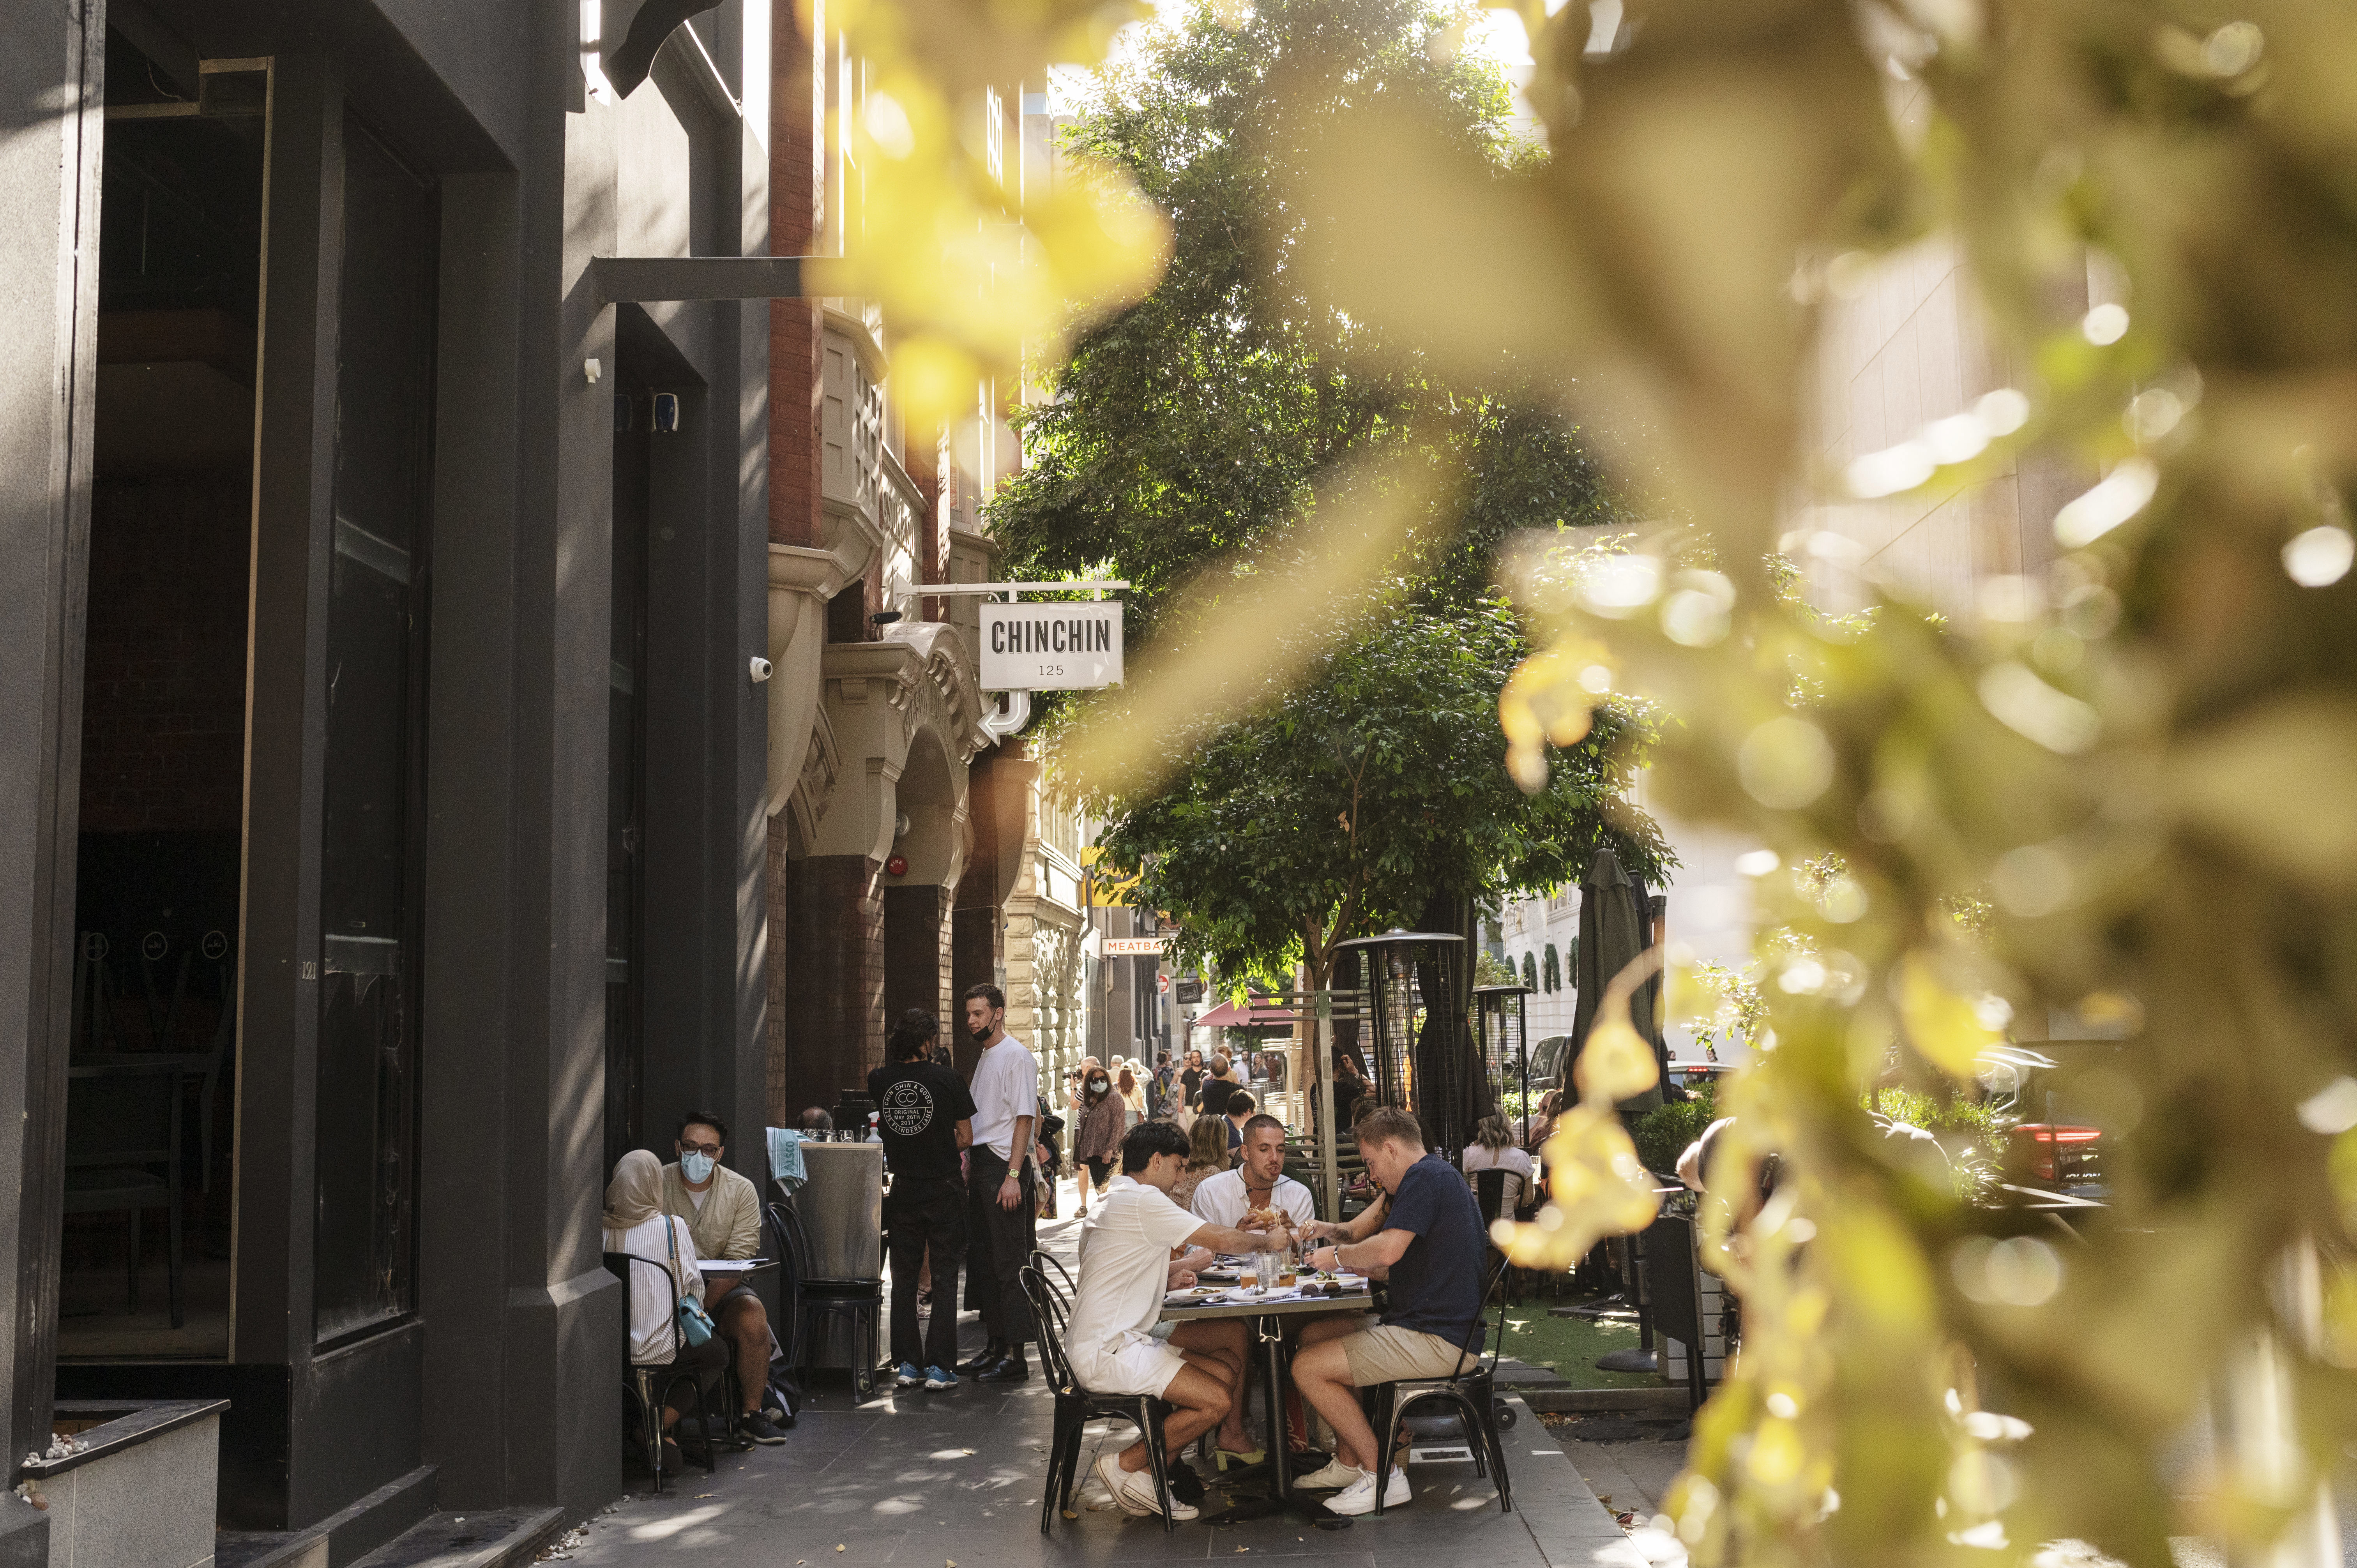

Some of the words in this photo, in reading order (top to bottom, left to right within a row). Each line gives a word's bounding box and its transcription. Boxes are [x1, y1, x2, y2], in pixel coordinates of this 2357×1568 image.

[1039, 665, 1064, 676] 125
[1108, 942, 1173, 951] MEATBA
[302, 961, 316, 980] 121
[885, 1090, 894, 1105] CHIN
[920, 1088, 931, 1104] GOGO
[898, 1093, 914, 1103] CC
[891, 1122, 922, 1134] FLINDERS
[922, 1110, 932, 1126] LANE
